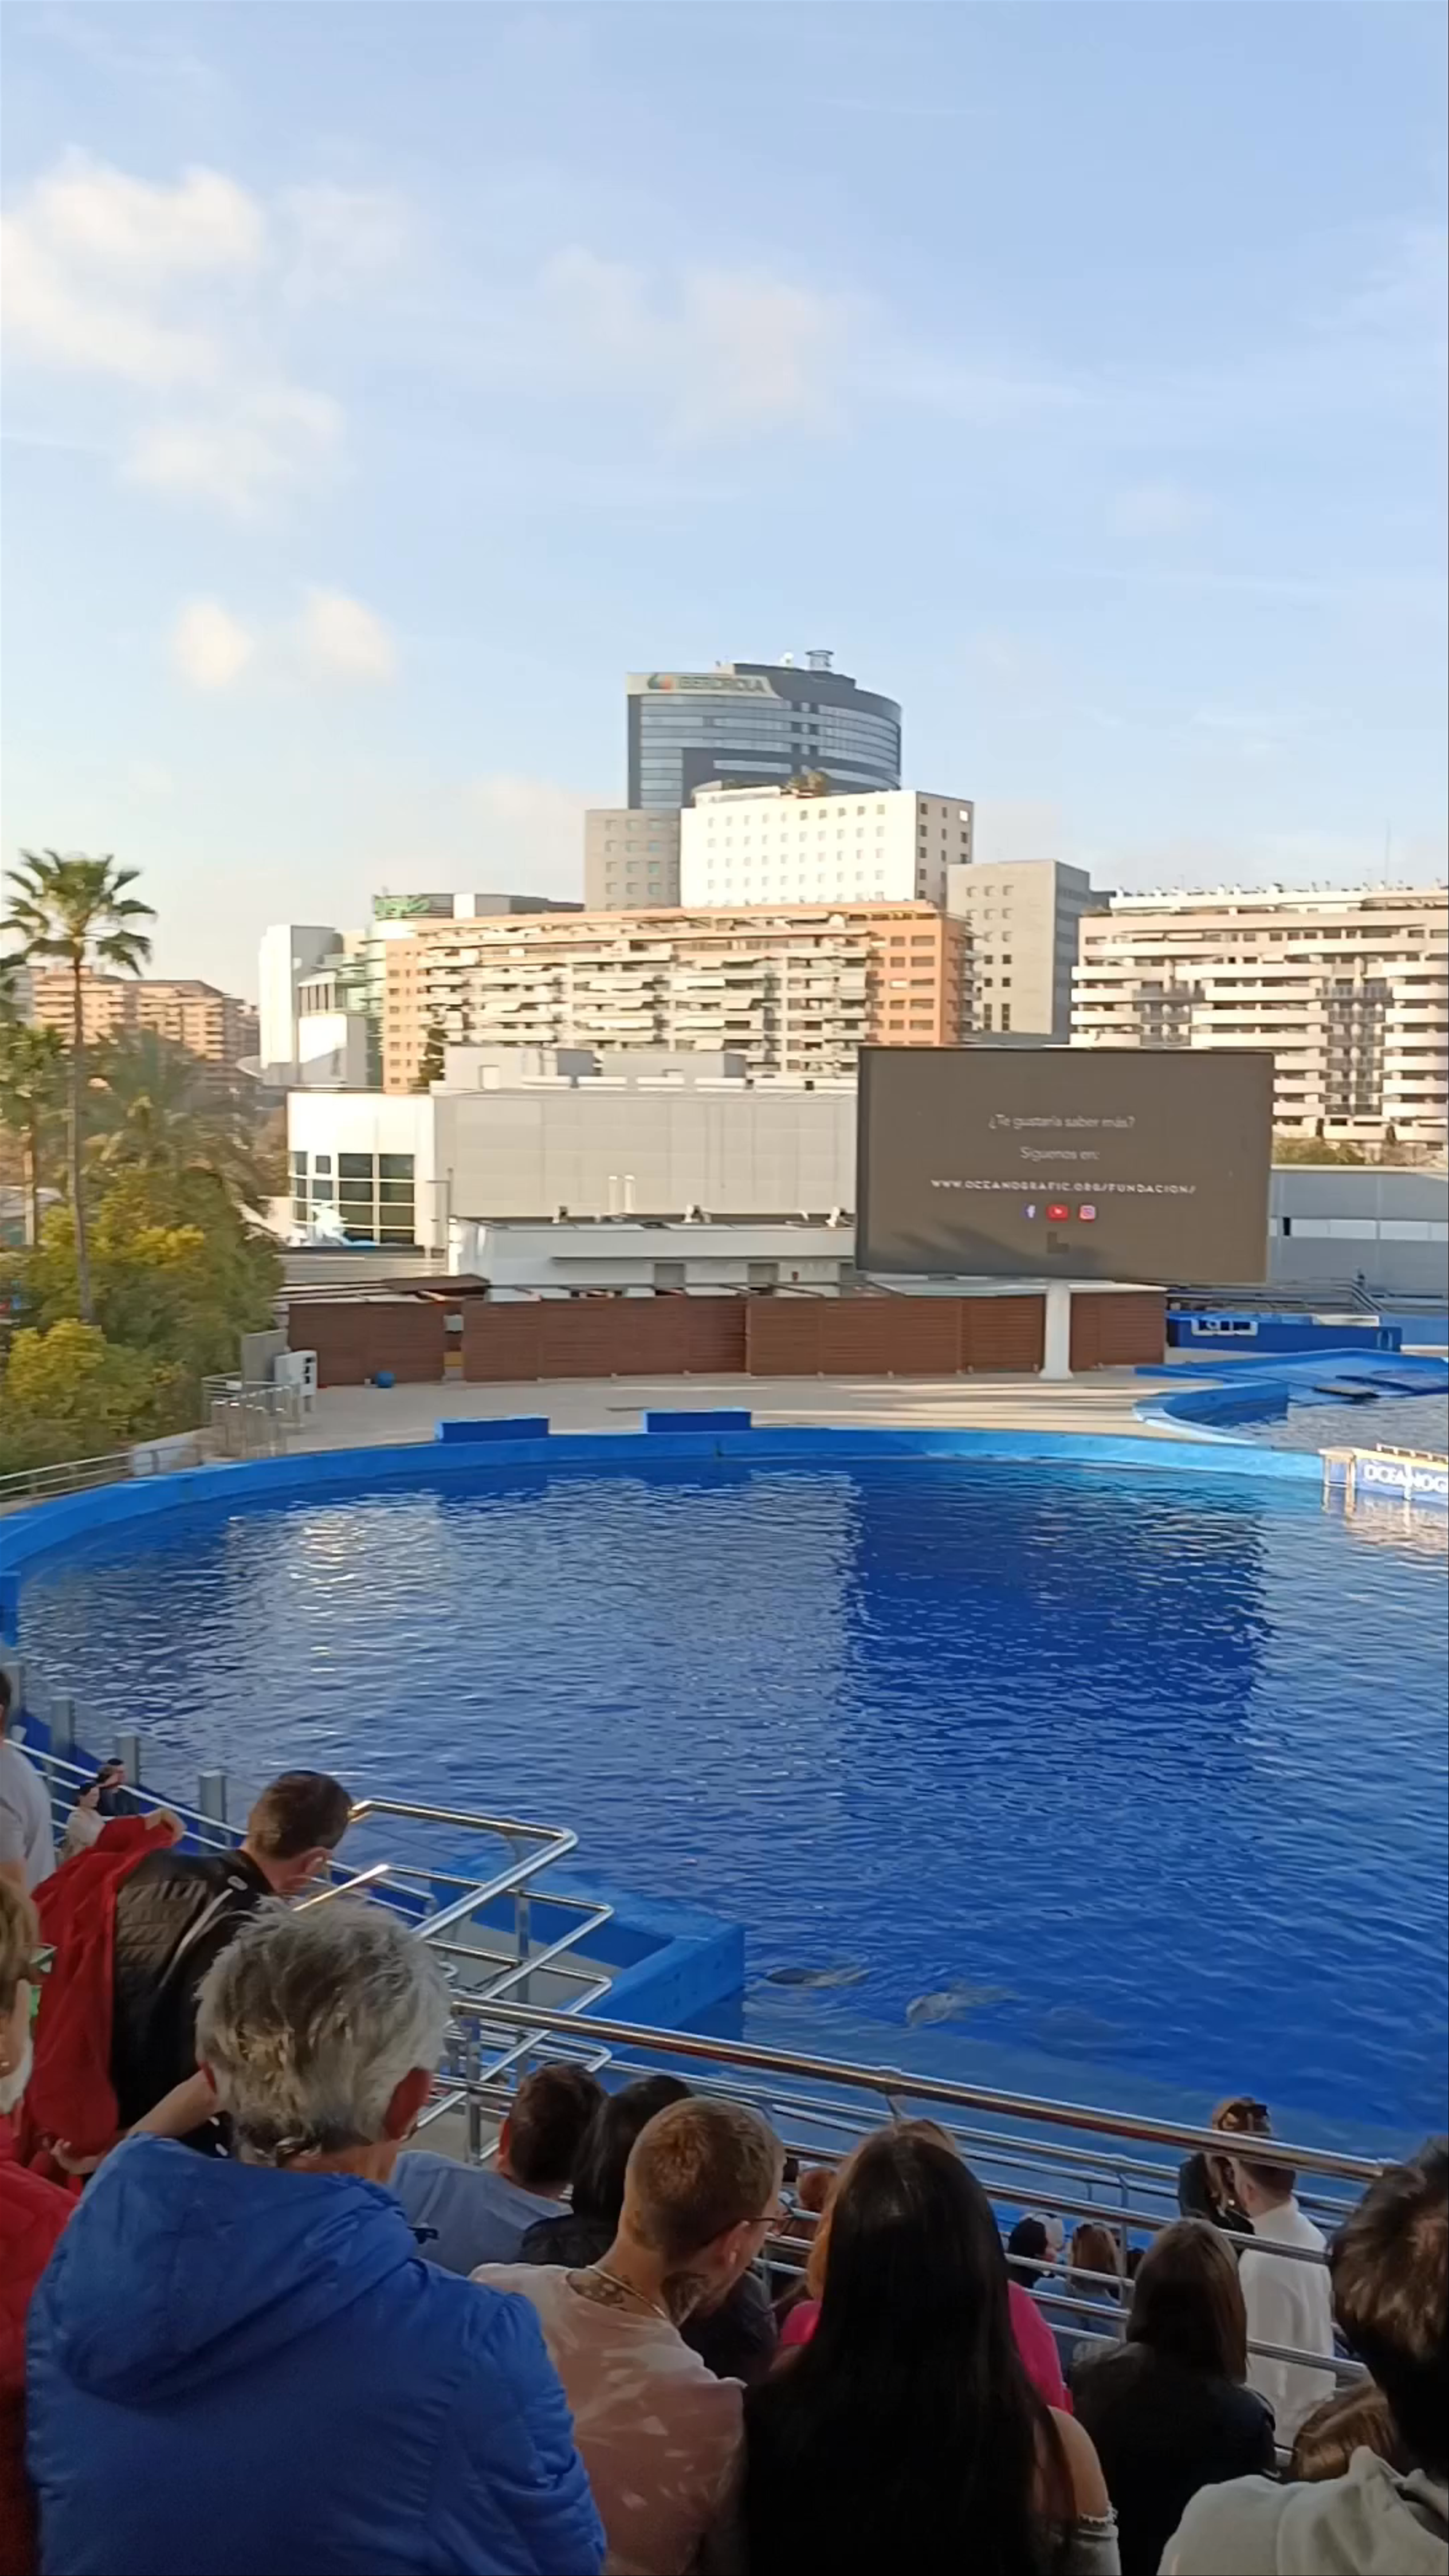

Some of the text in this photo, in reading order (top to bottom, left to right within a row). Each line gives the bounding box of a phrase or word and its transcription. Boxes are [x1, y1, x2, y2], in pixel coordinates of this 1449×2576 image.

[1064, 1116, 1099, 1127] saber
[1101, 1115, 1135, 1128] más?
[1080, 1150, 1100, 1160] en:
